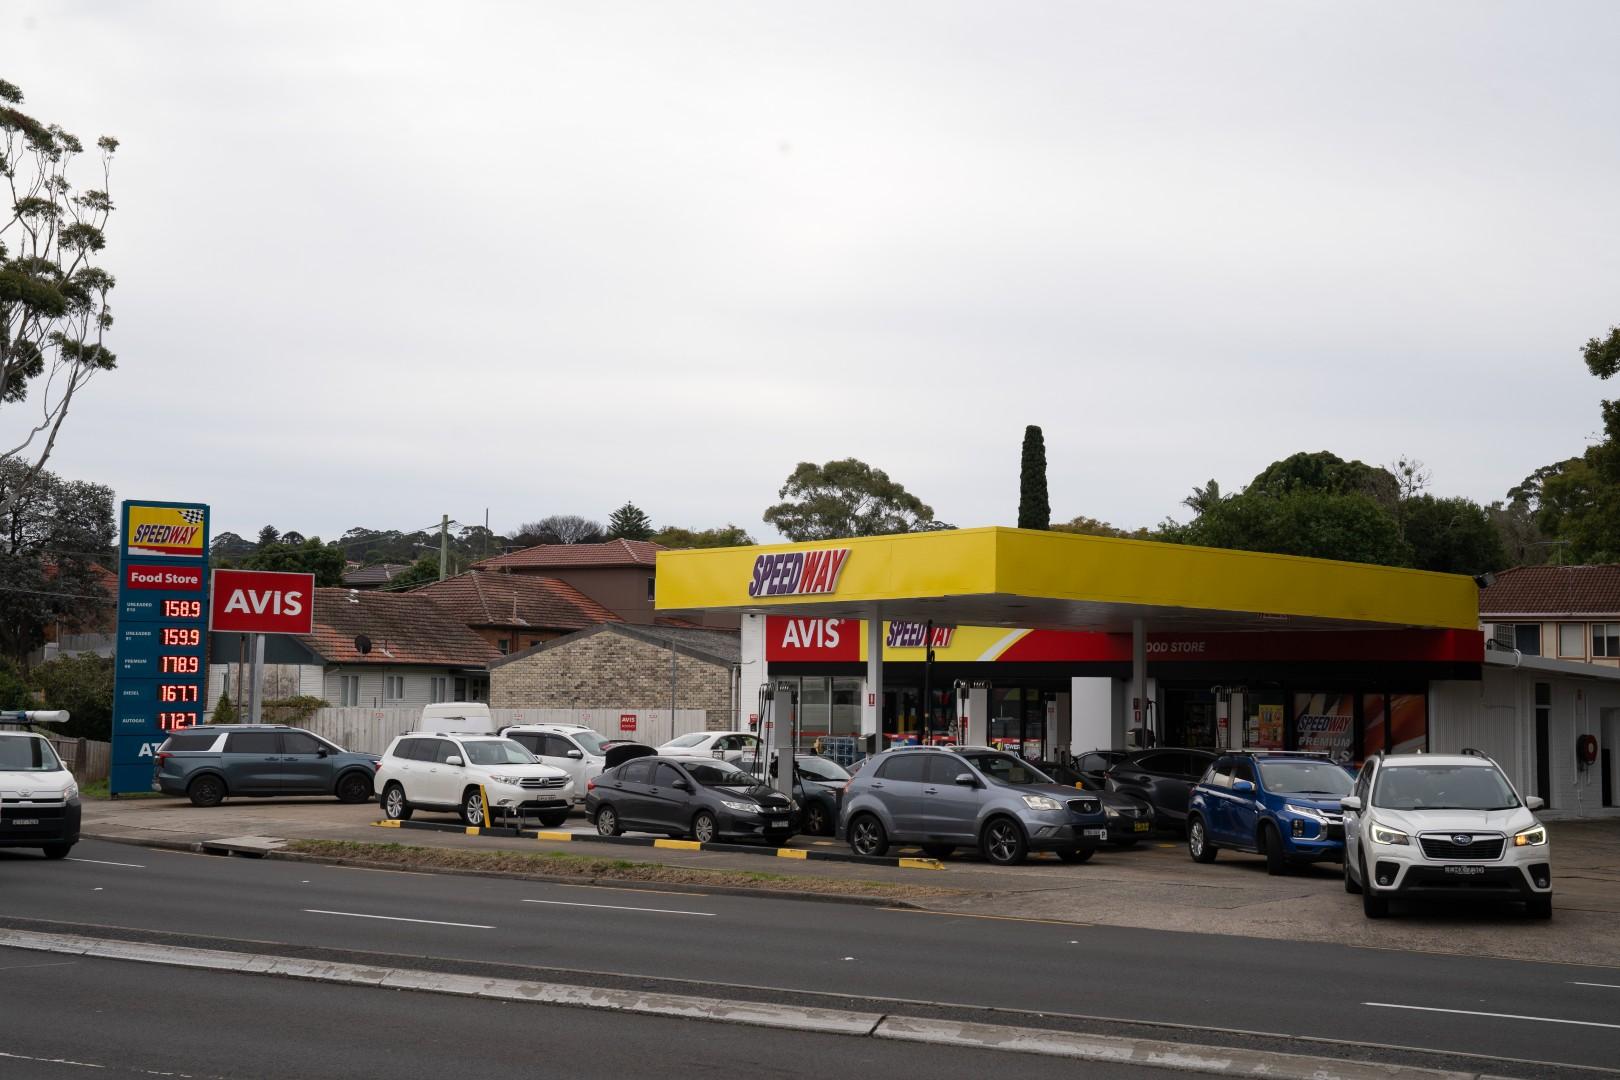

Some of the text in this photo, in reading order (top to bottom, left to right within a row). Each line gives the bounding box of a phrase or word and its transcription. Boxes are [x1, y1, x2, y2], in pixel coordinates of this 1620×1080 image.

[133, 524, 199, 545] SPEEDWAY
[131, 572, 198, 584] Food Store
[748, 549, 847, 597] SPEEDWAY
[164, 601, 201, 617] 158.9
[224, 588, 303, 616] AVIS
[163, 628, 200, 646] 159.9
[782, 618, 840, 648] AVIS
[1145, 641, 1207, 653] OOD STORE
[162, 656, 199, 673] 178.9
[161, 685, 198, 702] 167.7
[1298, 715, 1352, 731] SPEEDWAY
[138, 742, 163, 757] AT
[1298, 736, 1351, 747] PREMIUM
